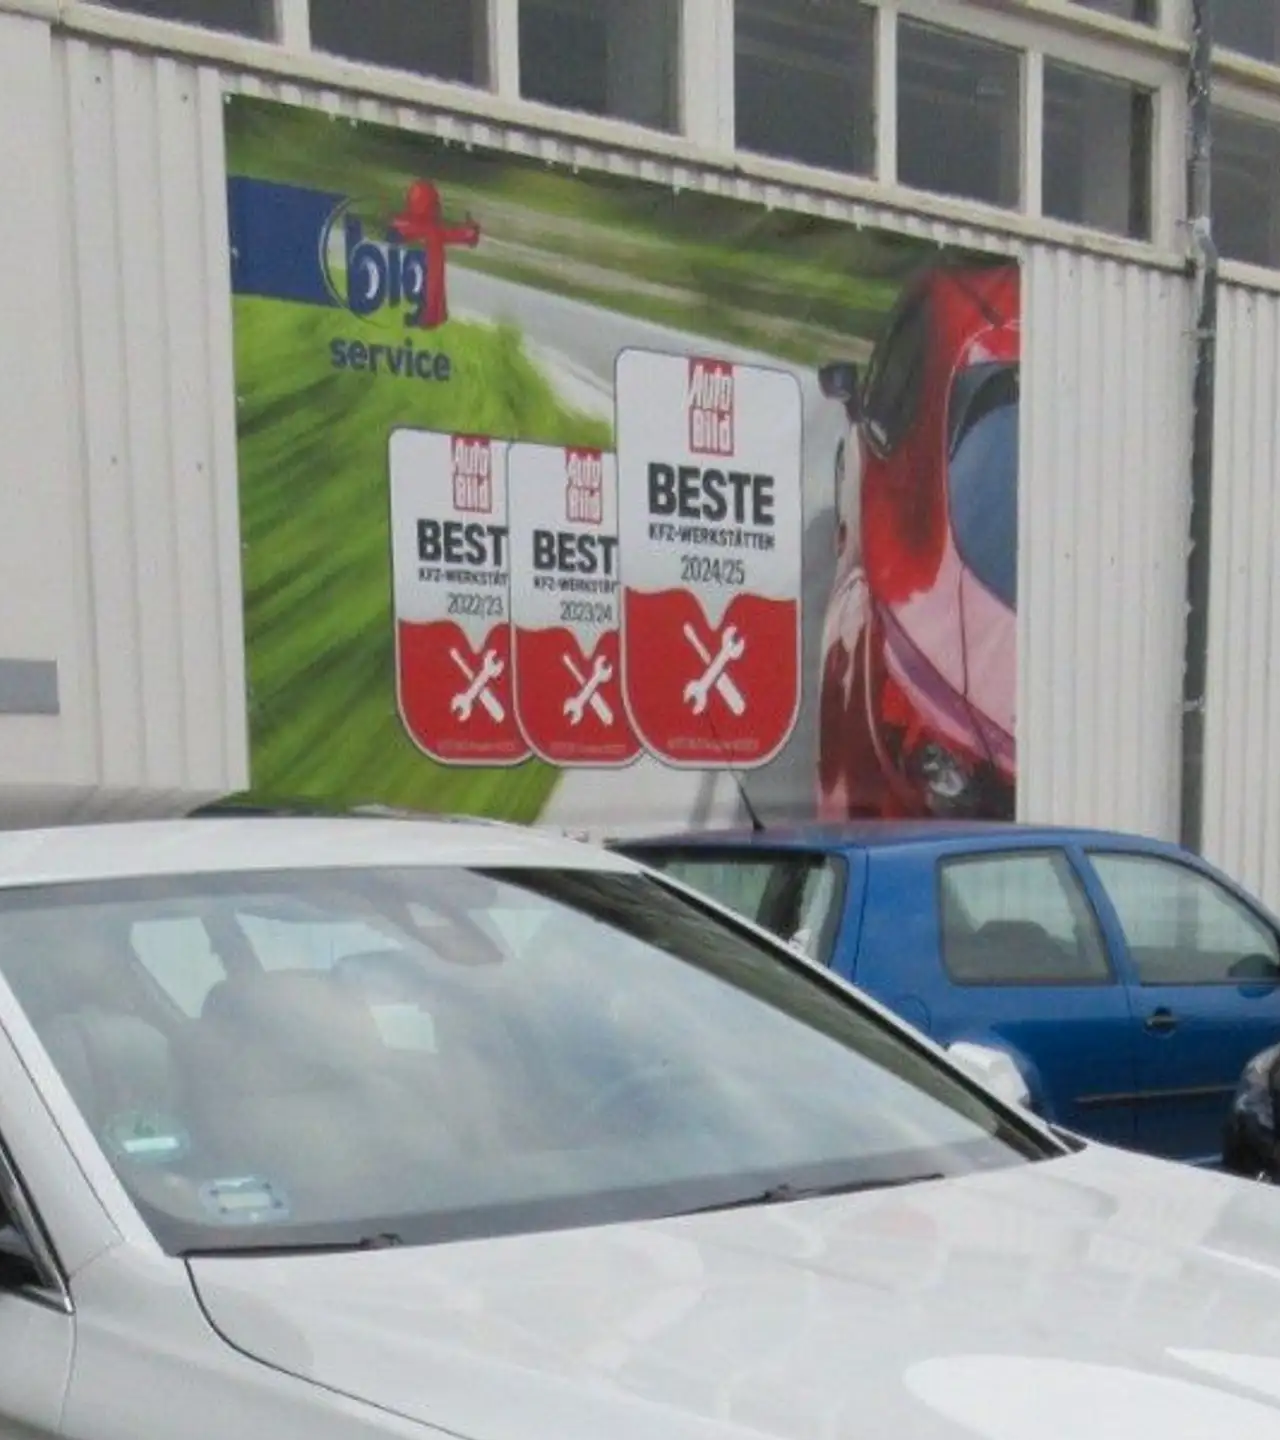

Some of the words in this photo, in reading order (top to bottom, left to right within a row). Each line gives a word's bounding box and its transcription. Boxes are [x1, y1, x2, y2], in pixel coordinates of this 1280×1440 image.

[329, 337, 451, 382] service
[648, 462, 774, 525] BESTE
[417, 518, 508, 566] BEST
[532, 529, 618, 574] BEST
[680, 554, 746, 585] 2024/25
